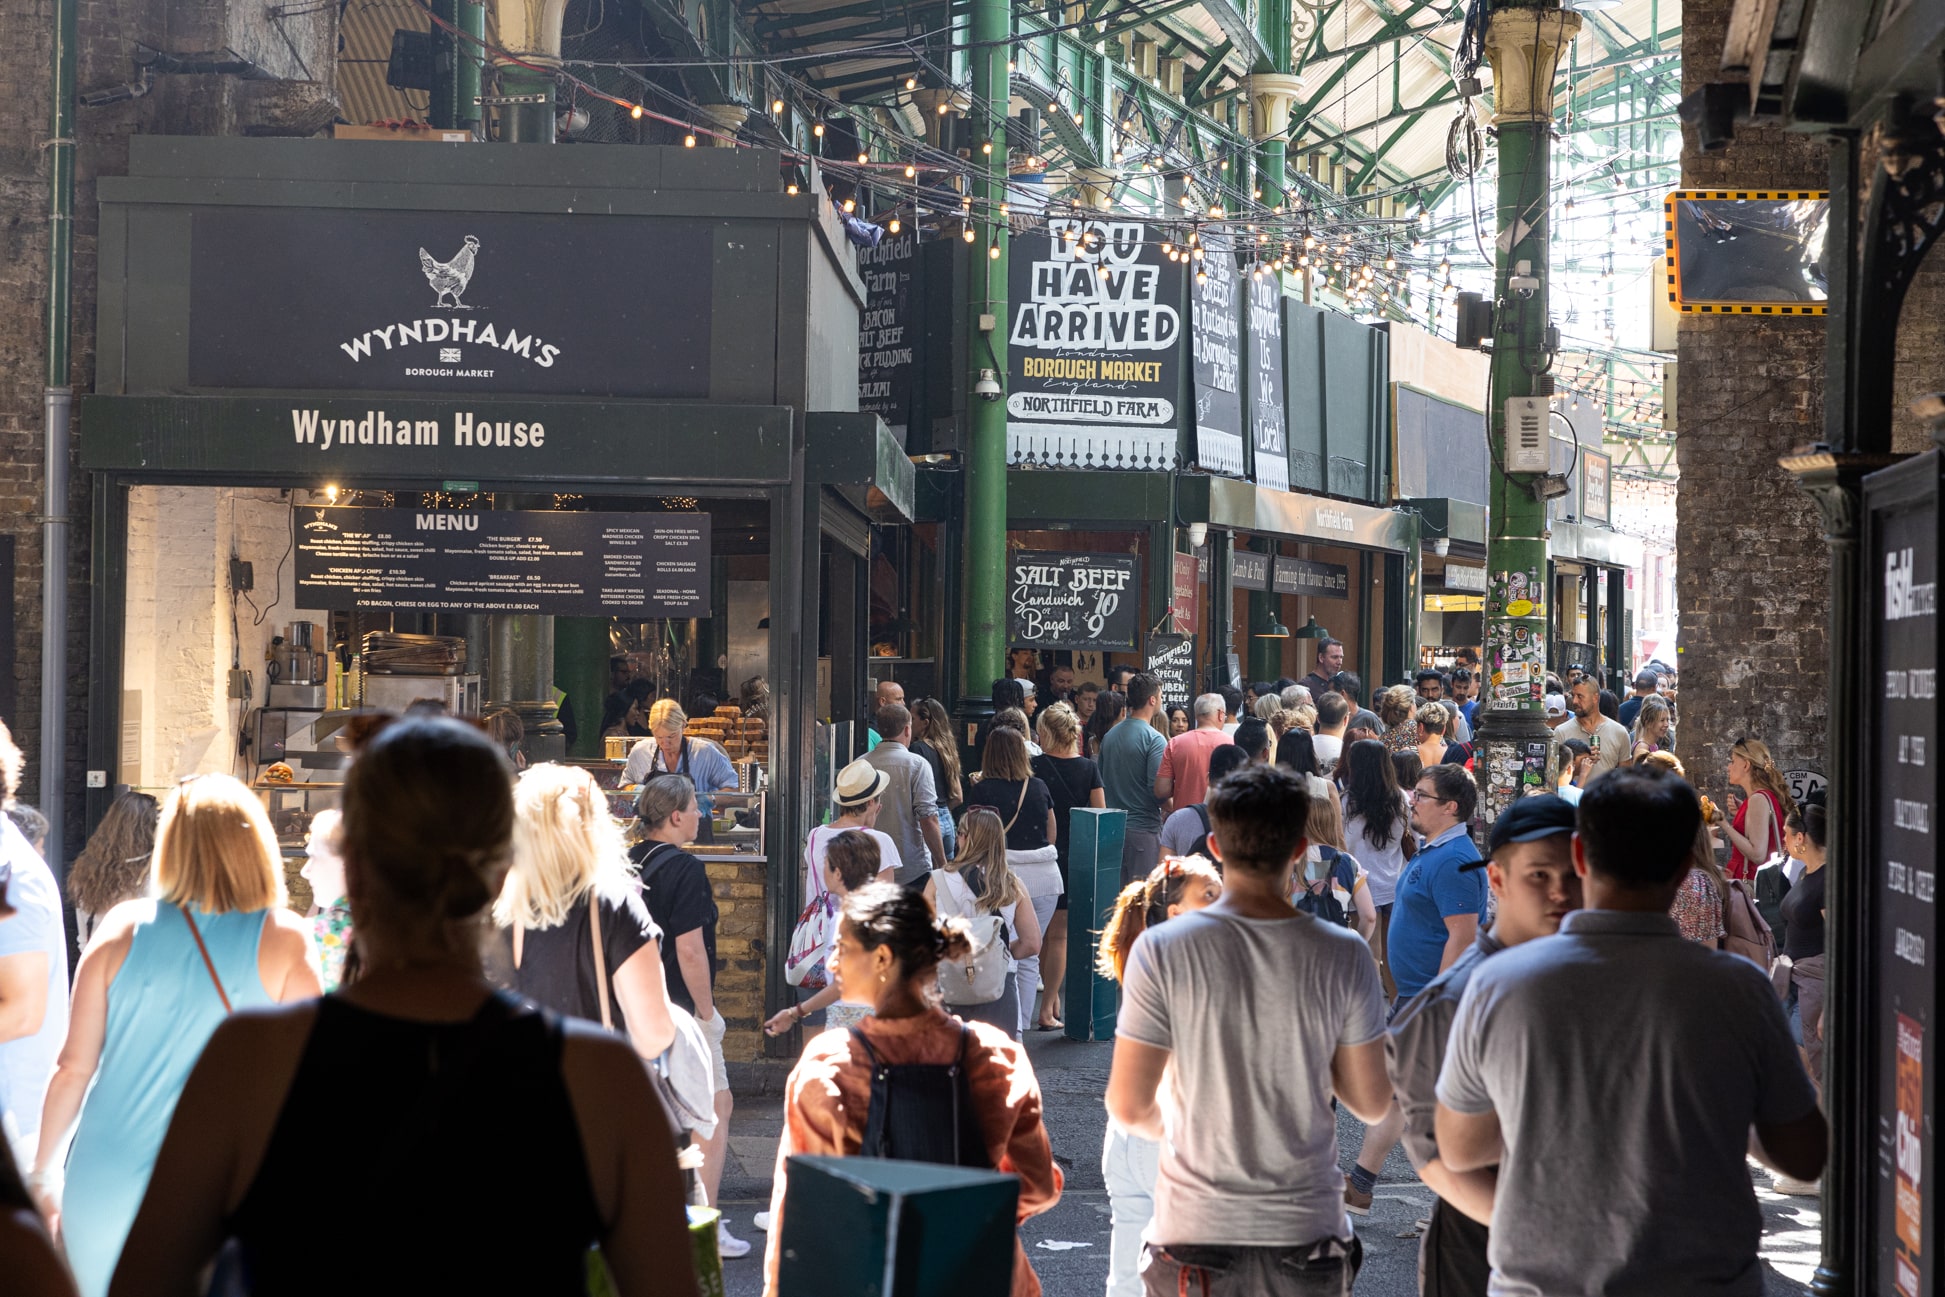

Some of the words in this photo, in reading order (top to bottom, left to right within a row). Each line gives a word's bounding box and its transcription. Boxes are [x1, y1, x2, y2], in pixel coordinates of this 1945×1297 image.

[1048, 220, 1144, 267] YOU
[864, 270, 896, 294] Farm
[1031, 261, 1160, 304] HAVE
[1258, 280, 1272, 309] You
[863, 309, 895, 330] BACON
[1010, 303, 1180, 350] ARRIVED
[1202, 304, 1228, 340] Rutland
[340, 318, 560, 368] WYNDHAM'S
[860, 331, 876, 348] ALT
[876, 326, 904, 348] BEEF
[874, 348, 912, 368] PUDDING
[1056, 348, 1133, 358] London
[1202, 335, 1230, 372] Borough
[1260, 339, 1270, 370] Us
[406, 368, 453, 377] BOROUGH
[456, 369, 494, 377] MARKET
[1024, 358, 1096, 379] BOROUGH
[1101, 361, 1162, 382] MARKET
[1213, 363, 1236, 394] Market
[1043, 378, 1137, 394] England
[1259, 372, 1273, 406] We
[1023, 396, 1112, 417] NORTHFIELD
[1118, 401, 1160, 418] FARM
[292, 409, 438, 450] Wyndham
[455, 412, 544, 447] House
[1259, 419, 1281, 452] Local
[416, 514, 478, 531] MENU
[1316, 507, 1341, 530] Northfield
[1341, 512, 1354, 531] Farm
[1014, 566, 1064, 587] SALT
[1068, 568, 1130, 592] BEEF
[1232, 558, 1247, 578] Lamb
[1253, 561, 1265, 580] Pork
[1275, 564, 1297, 590] Farming
[1012, 585, 1084, 614] Sandwich
[1022, 608, 1071, 640] Bagel
[1148, 641, 1192, 670] NORTHFIELD
[1154, 669, 1183, 681] SPECIAL
[1162, 682, 1185, 692] UBEN
